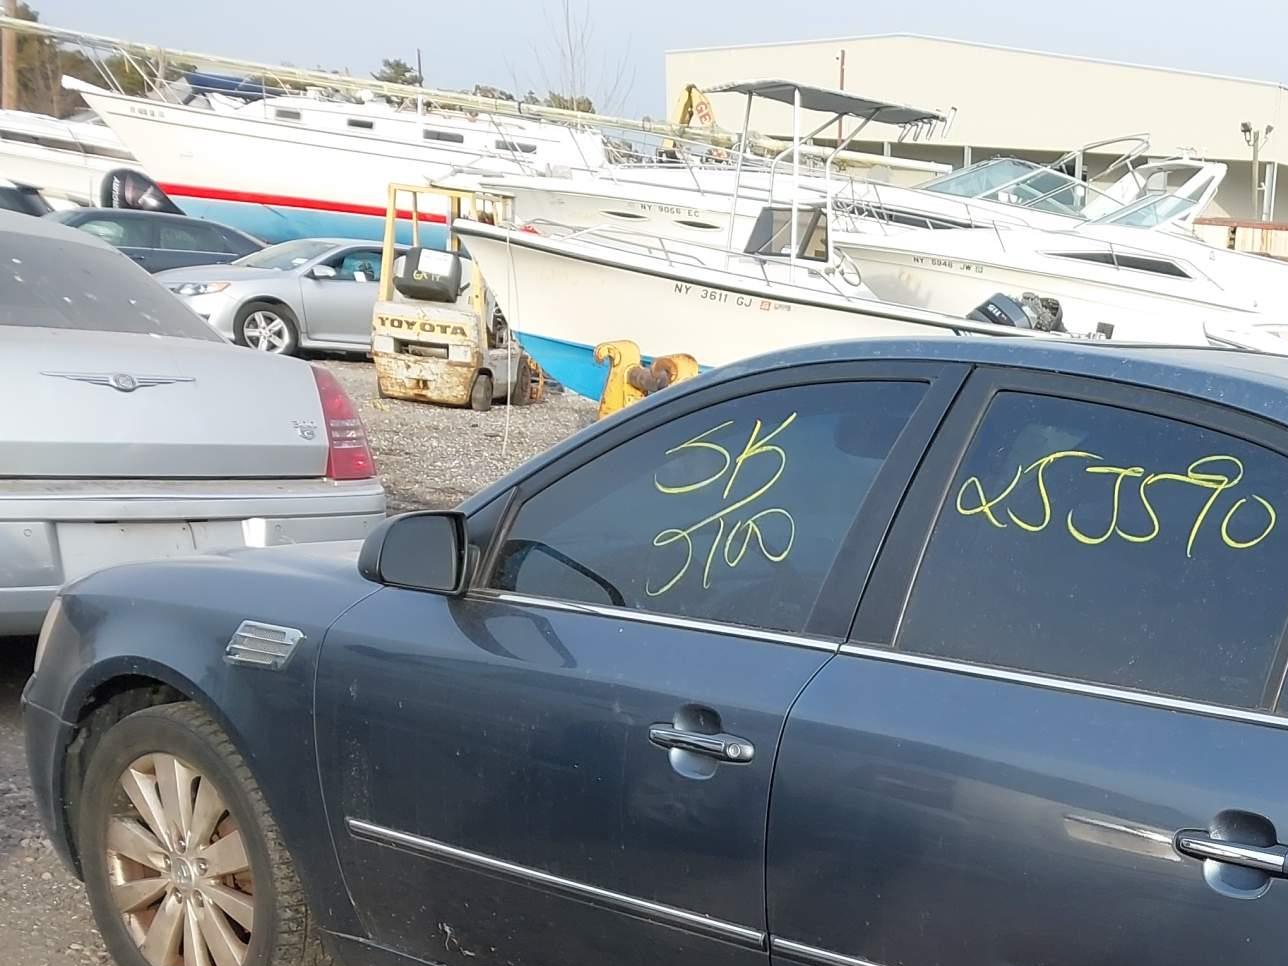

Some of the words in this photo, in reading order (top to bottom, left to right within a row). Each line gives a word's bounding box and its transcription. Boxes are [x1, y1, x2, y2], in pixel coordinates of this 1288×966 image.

[674, 283, 692, 295] NY
[700, 289, 728, 303] 3611
[736, 296, 753, 308] GJ
[378, 316, 468, 337] TOYOTA
